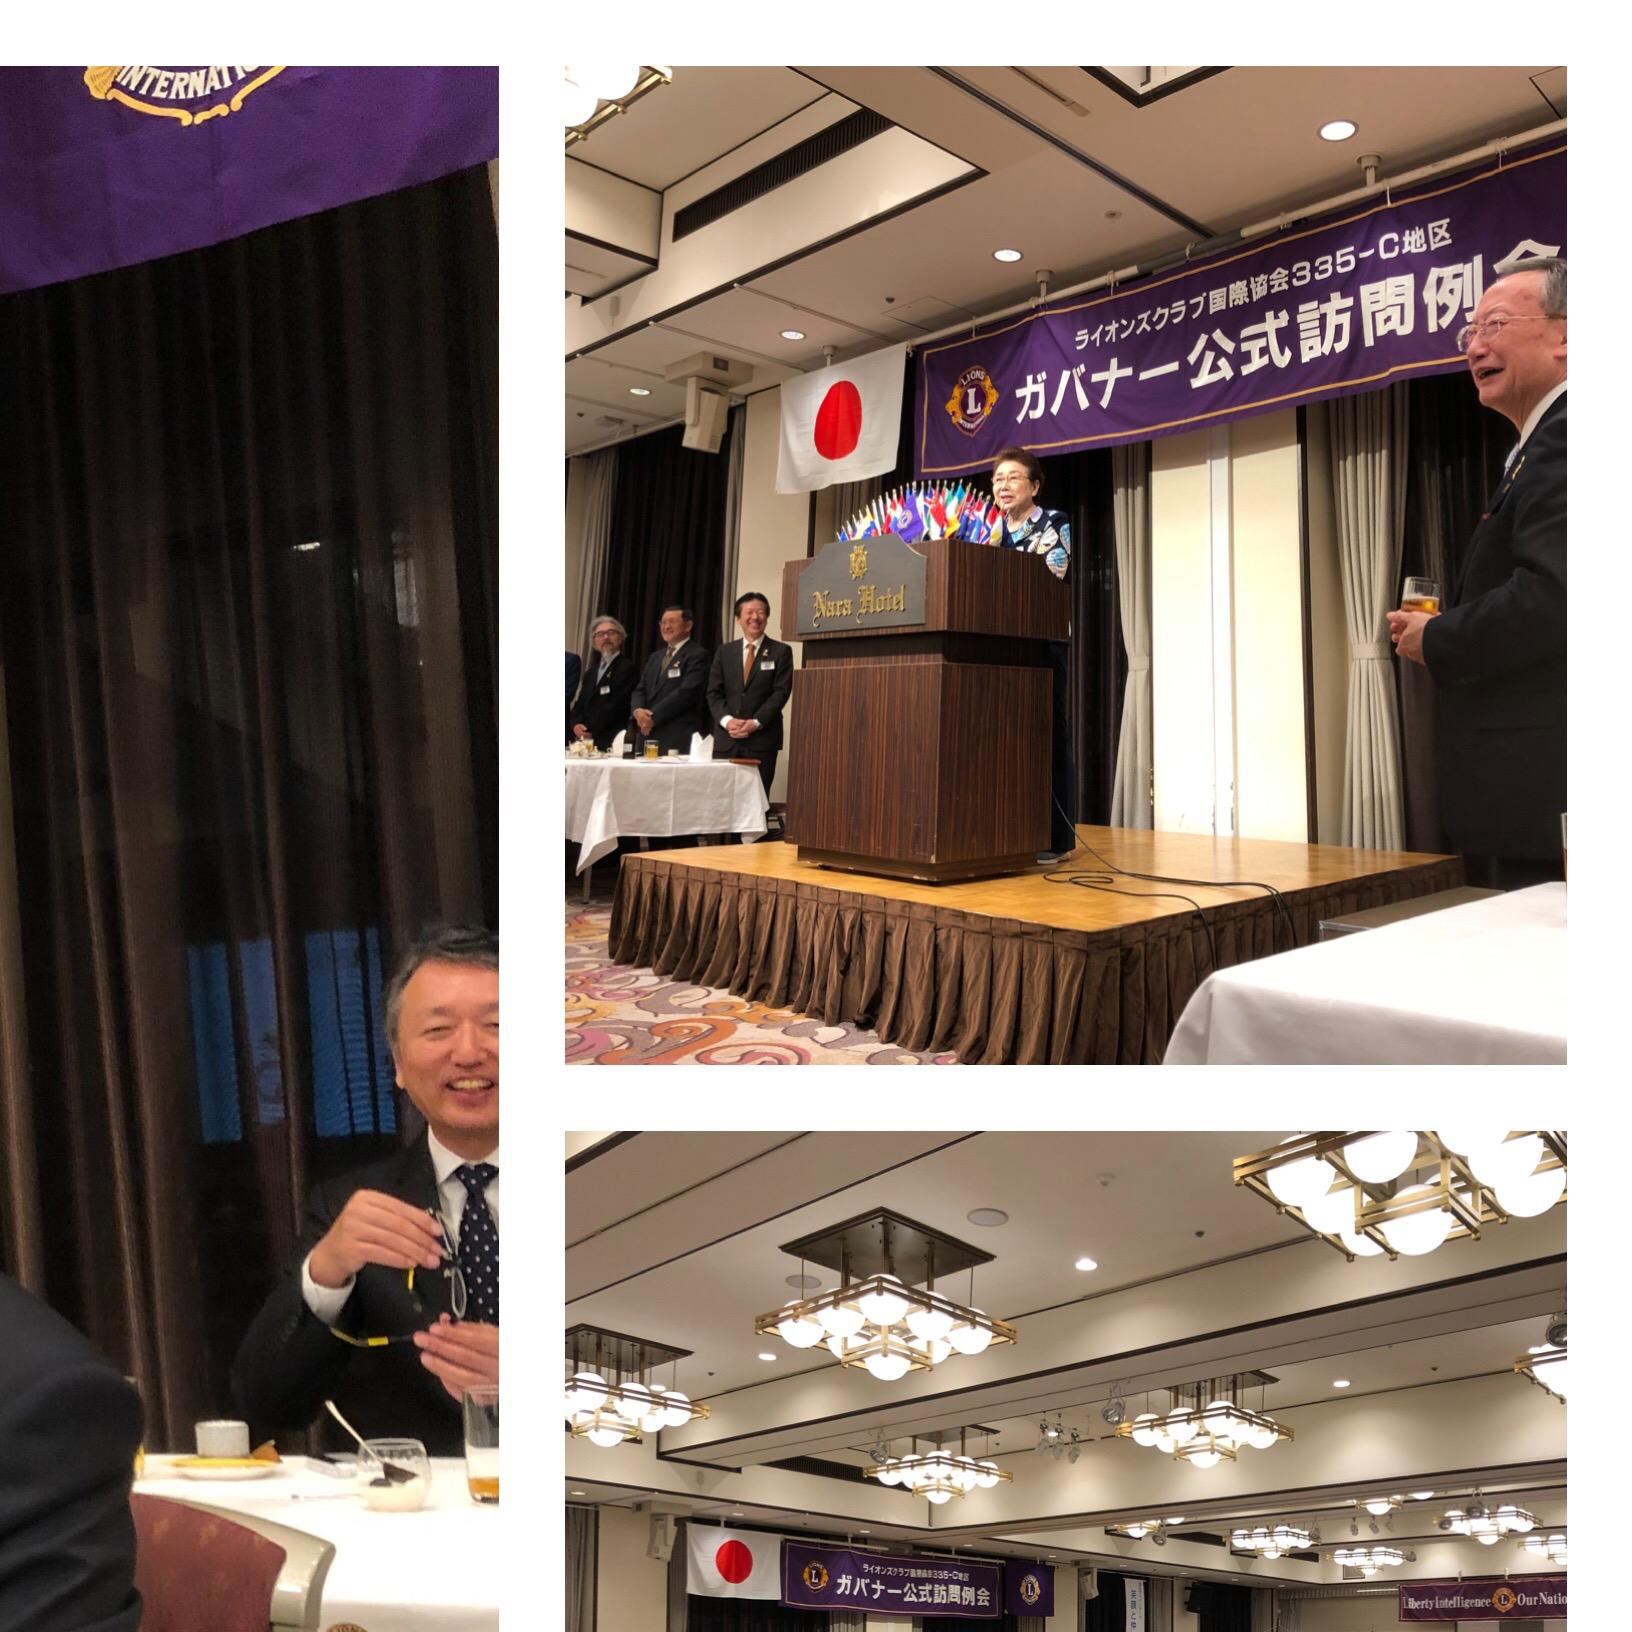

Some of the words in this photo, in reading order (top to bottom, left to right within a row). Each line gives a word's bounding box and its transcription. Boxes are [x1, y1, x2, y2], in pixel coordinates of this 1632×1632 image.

[967, 388, 981, 415] L
[812, 591, 853, 628] Nara
[856, 584, 906, 624] Hotel
